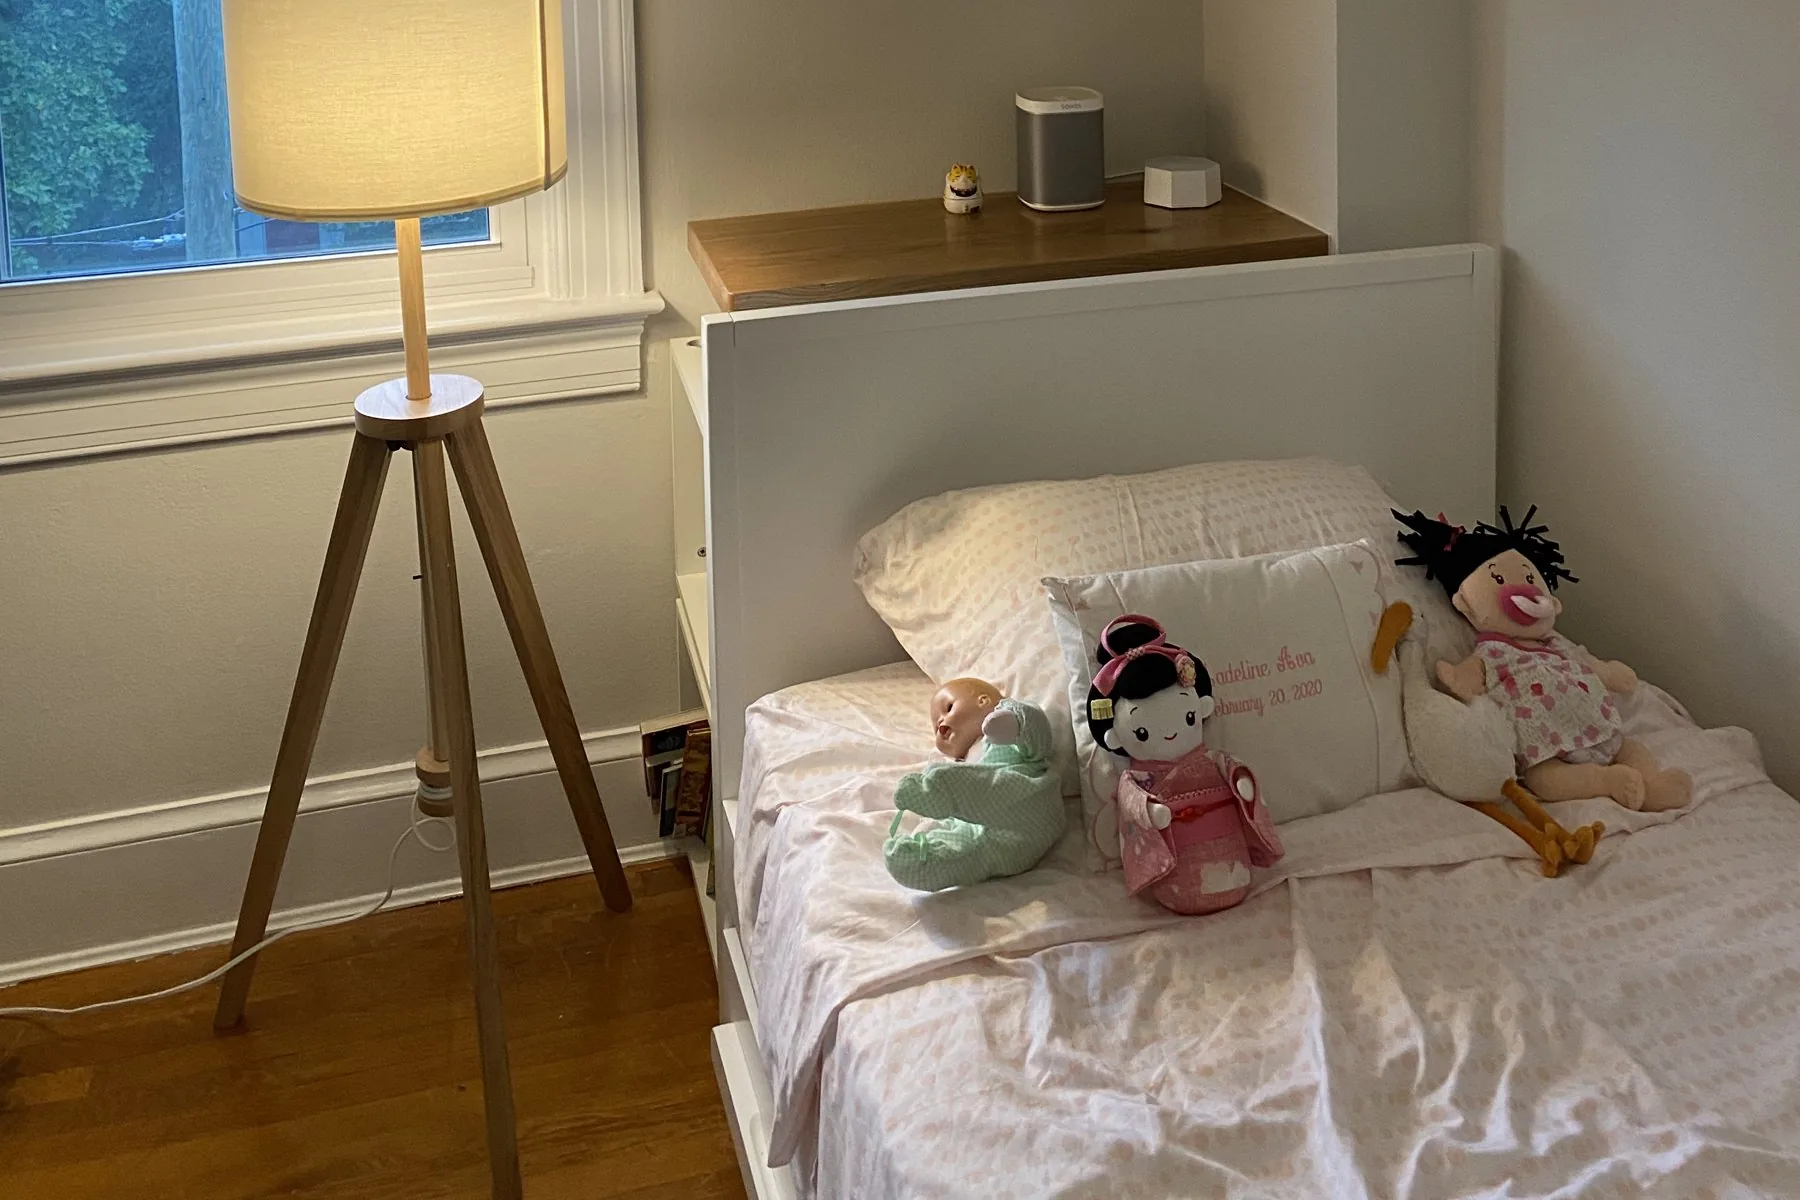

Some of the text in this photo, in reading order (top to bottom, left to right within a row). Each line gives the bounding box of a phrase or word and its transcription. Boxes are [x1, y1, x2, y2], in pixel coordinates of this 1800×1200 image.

[1276, 646, 1316, 673] Ava
[1213, 696, 1265, 717] ebruary
[1292, 678, 1323, 700] 2020
